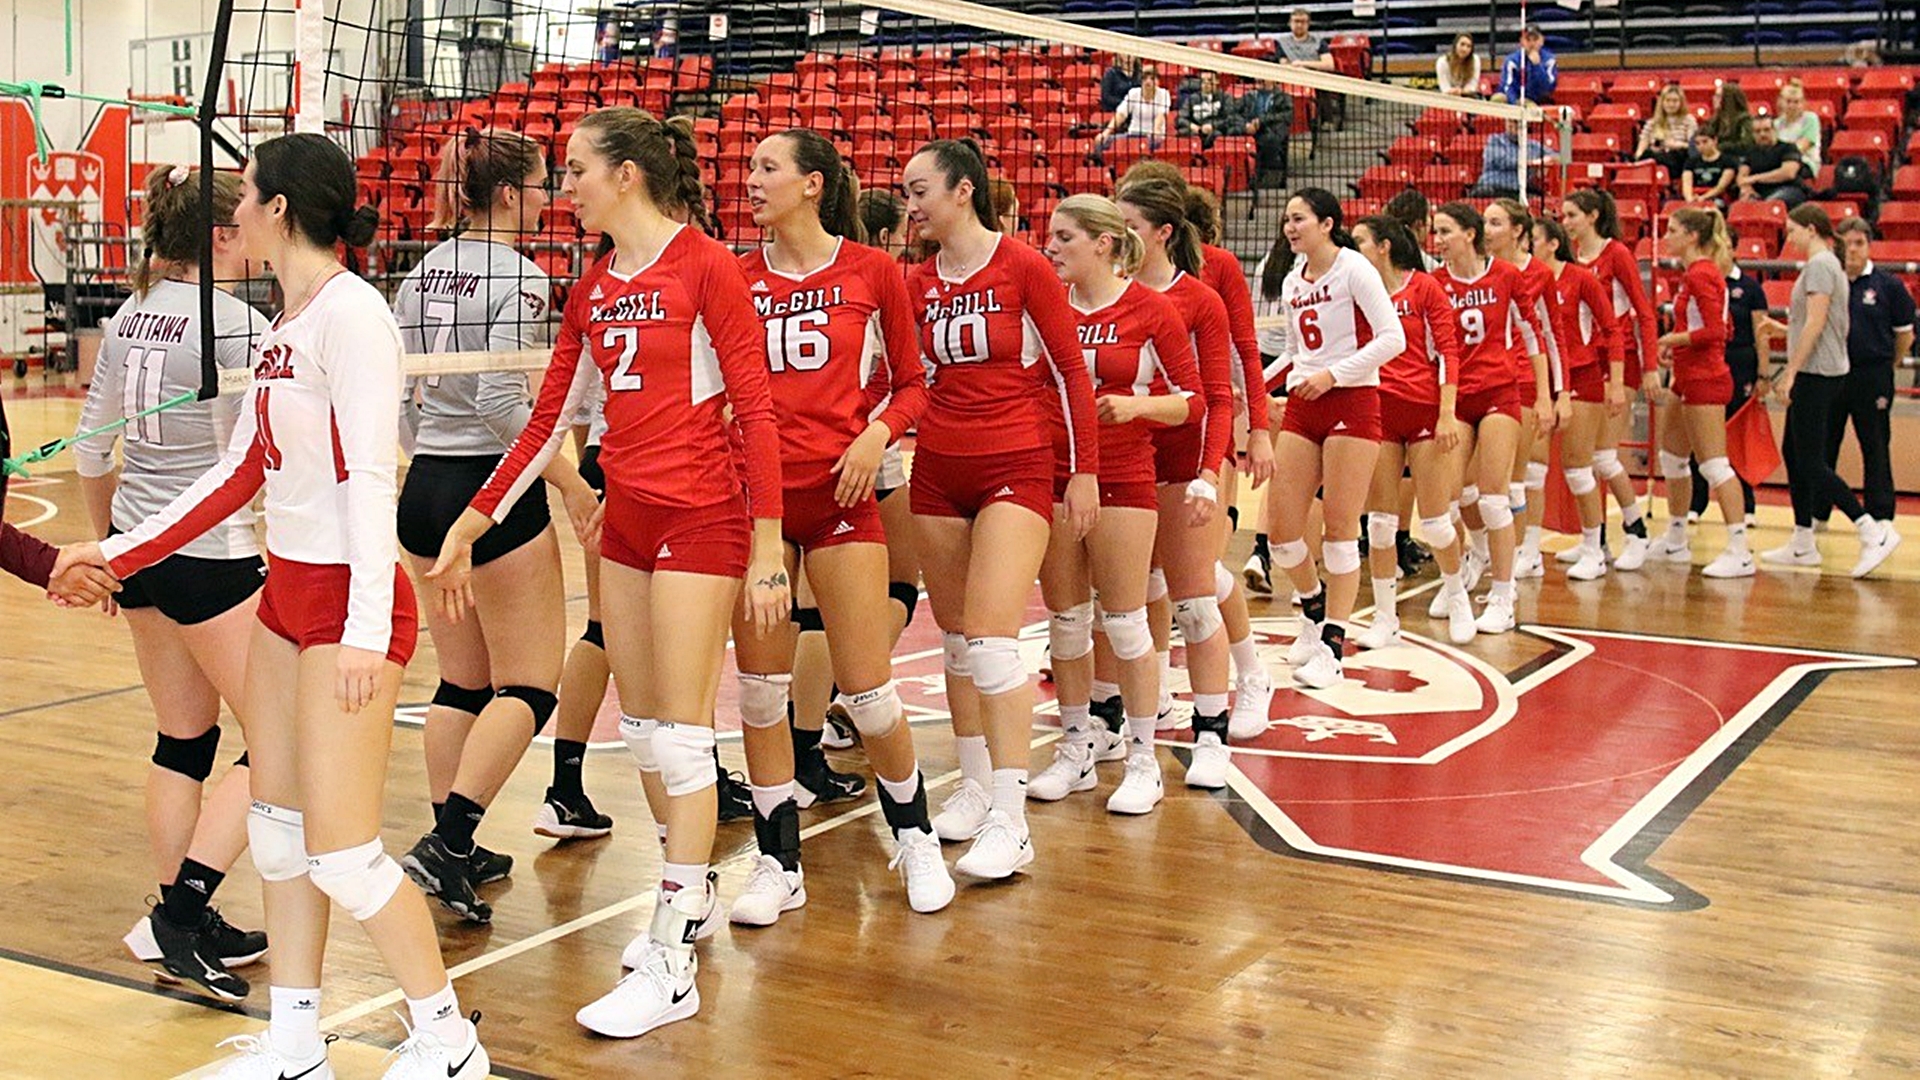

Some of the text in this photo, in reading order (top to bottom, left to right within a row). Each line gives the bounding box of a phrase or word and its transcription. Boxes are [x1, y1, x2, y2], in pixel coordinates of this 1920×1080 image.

[764, 308, 831, 373] 16
[931, 312, 990, 366] 10
[1076, 322, 1119, 345] GILL
[1298, 308, 1324, 351] 6
[1460, 307, 1487, 346] 9
[602, 325, 644, 392] 2
[122, 344, 169, 446] 11
